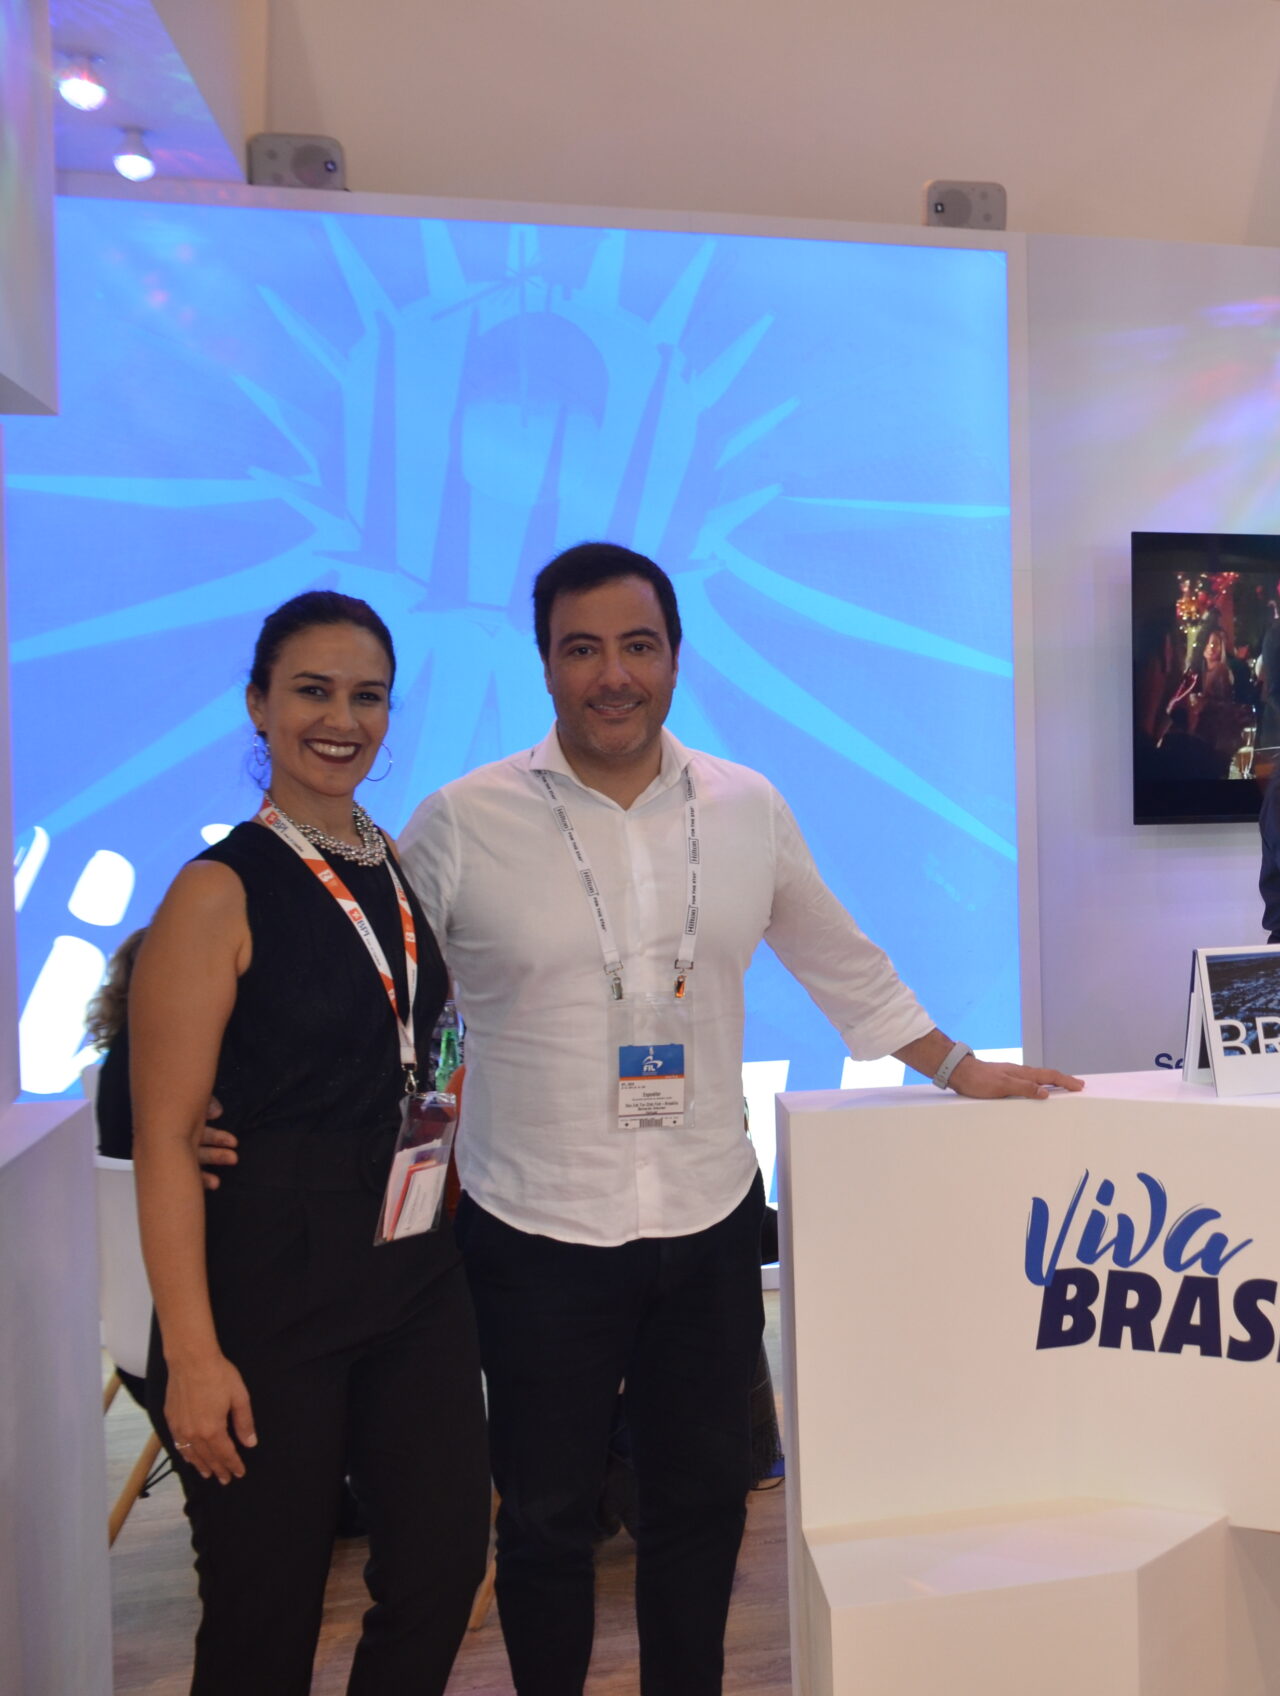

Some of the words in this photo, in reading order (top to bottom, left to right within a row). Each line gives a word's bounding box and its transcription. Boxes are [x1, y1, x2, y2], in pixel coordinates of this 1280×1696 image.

[272, 819, 289, 834] BPI
[556, 807, 570, 830] Hilton
[583, 871, 595, 894] Hilton
[357, 919, 371, 937] BPI
[687, 908, 697, 934] Hilton
[1025, 1168, 1253, 1287] Viva
